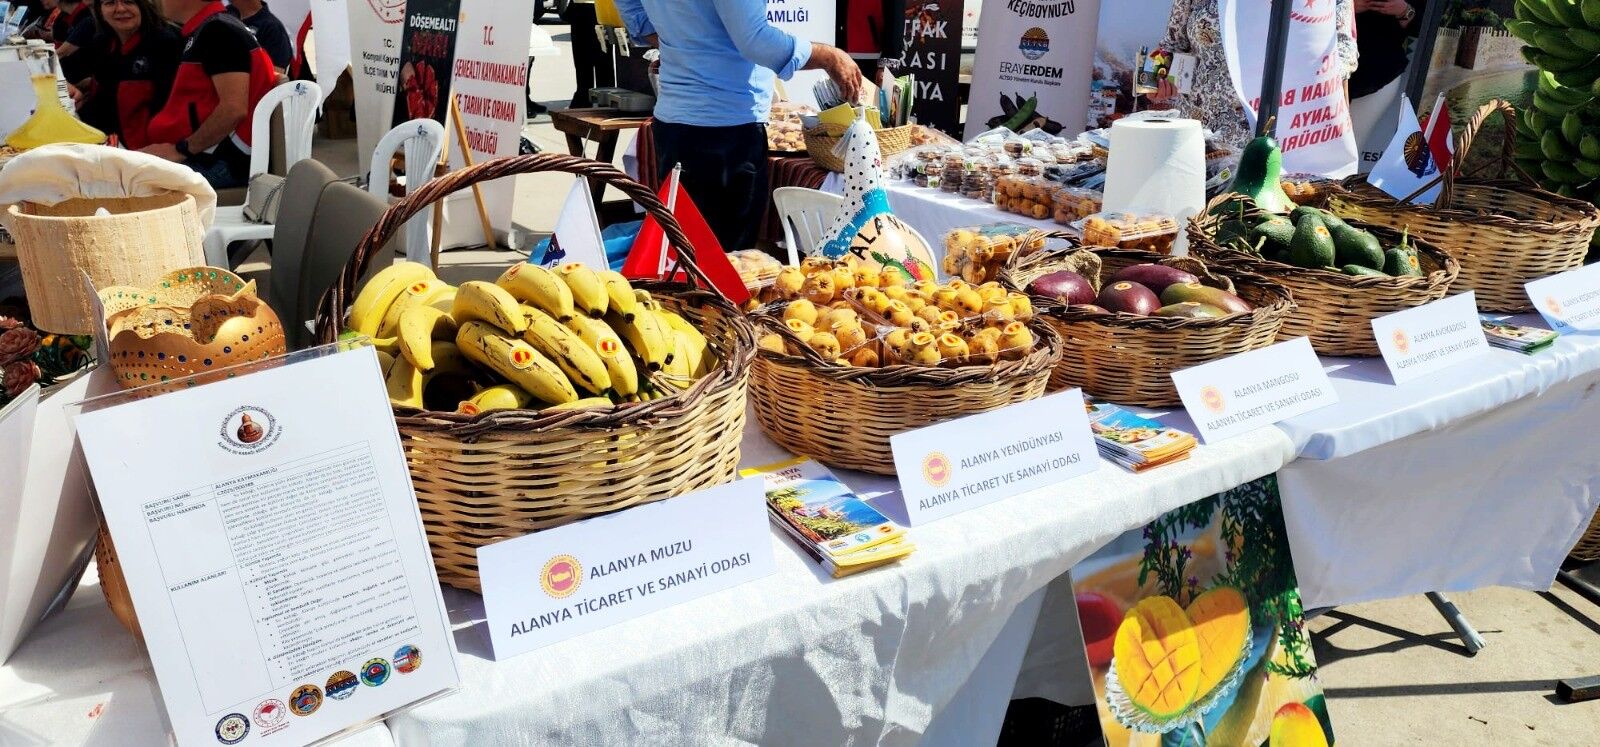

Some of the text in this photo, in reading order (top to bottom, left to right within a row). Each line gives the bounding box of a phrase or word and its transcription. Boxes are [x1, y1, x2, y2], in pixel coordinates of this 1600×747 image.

[410, 12, 456, 32] DÖŞEMEALTI
[1007, 0, 1075, 18] KEÇİBOYNUZU
[463, 95, 482, 116] TARIM
[482, 98, 492, 118] VE
[492, 100, 517, 122] ORMAN
[1234, 372, 1300, 399] ALANYA MANGOSU
[1206, 387, 1323, 431] ALANYA TİCARET VE SANAYİ ODASI
[961, 431, 1063, 470] ALANYA YENİDÜNYASI
[919, 452, 1081, 511] ALANYA TİCARET VE SANAYİ ODASI
[590, 539, 693, 580] ALANYA MUZU
[510, 552, 751, 638] ALANYA TİCARET VE SANAYİ ODASI
